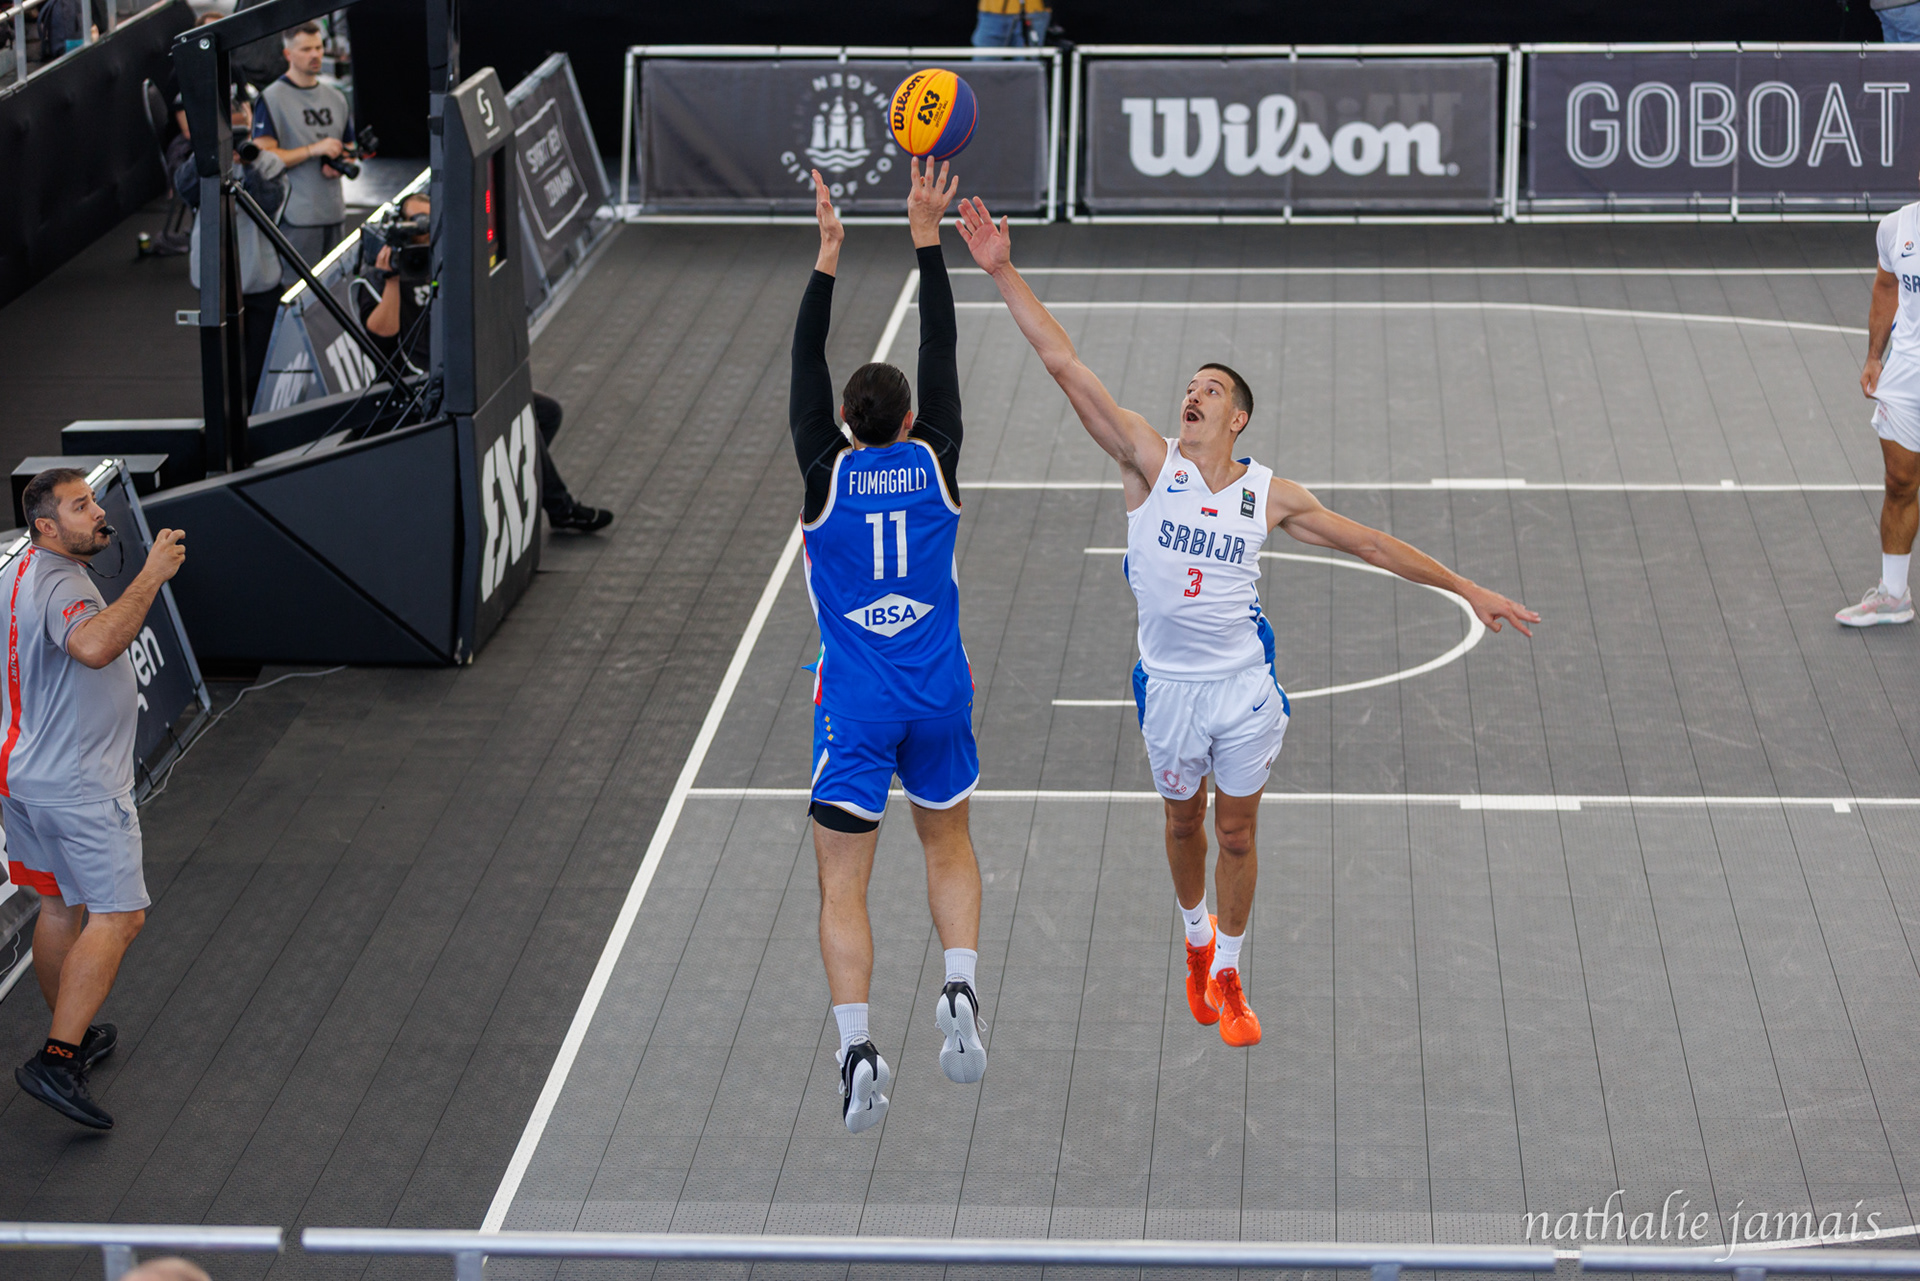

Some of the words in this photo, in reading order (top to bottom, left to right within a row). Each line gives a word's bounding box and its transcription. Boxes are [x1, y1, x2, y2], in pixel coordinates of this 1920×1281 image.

[894, 75, 925, 130] Wilson
[1566, 81, 1910, 168] GOBOAT
[1121, 94, 1446, 177] Wilson
[865, 510, 908, 581] 11
[1158, 519, 1246, 565] SRBIJA
[1183, 567, 1203, 598] 3
[864, 604, 917, 627] IBSA
